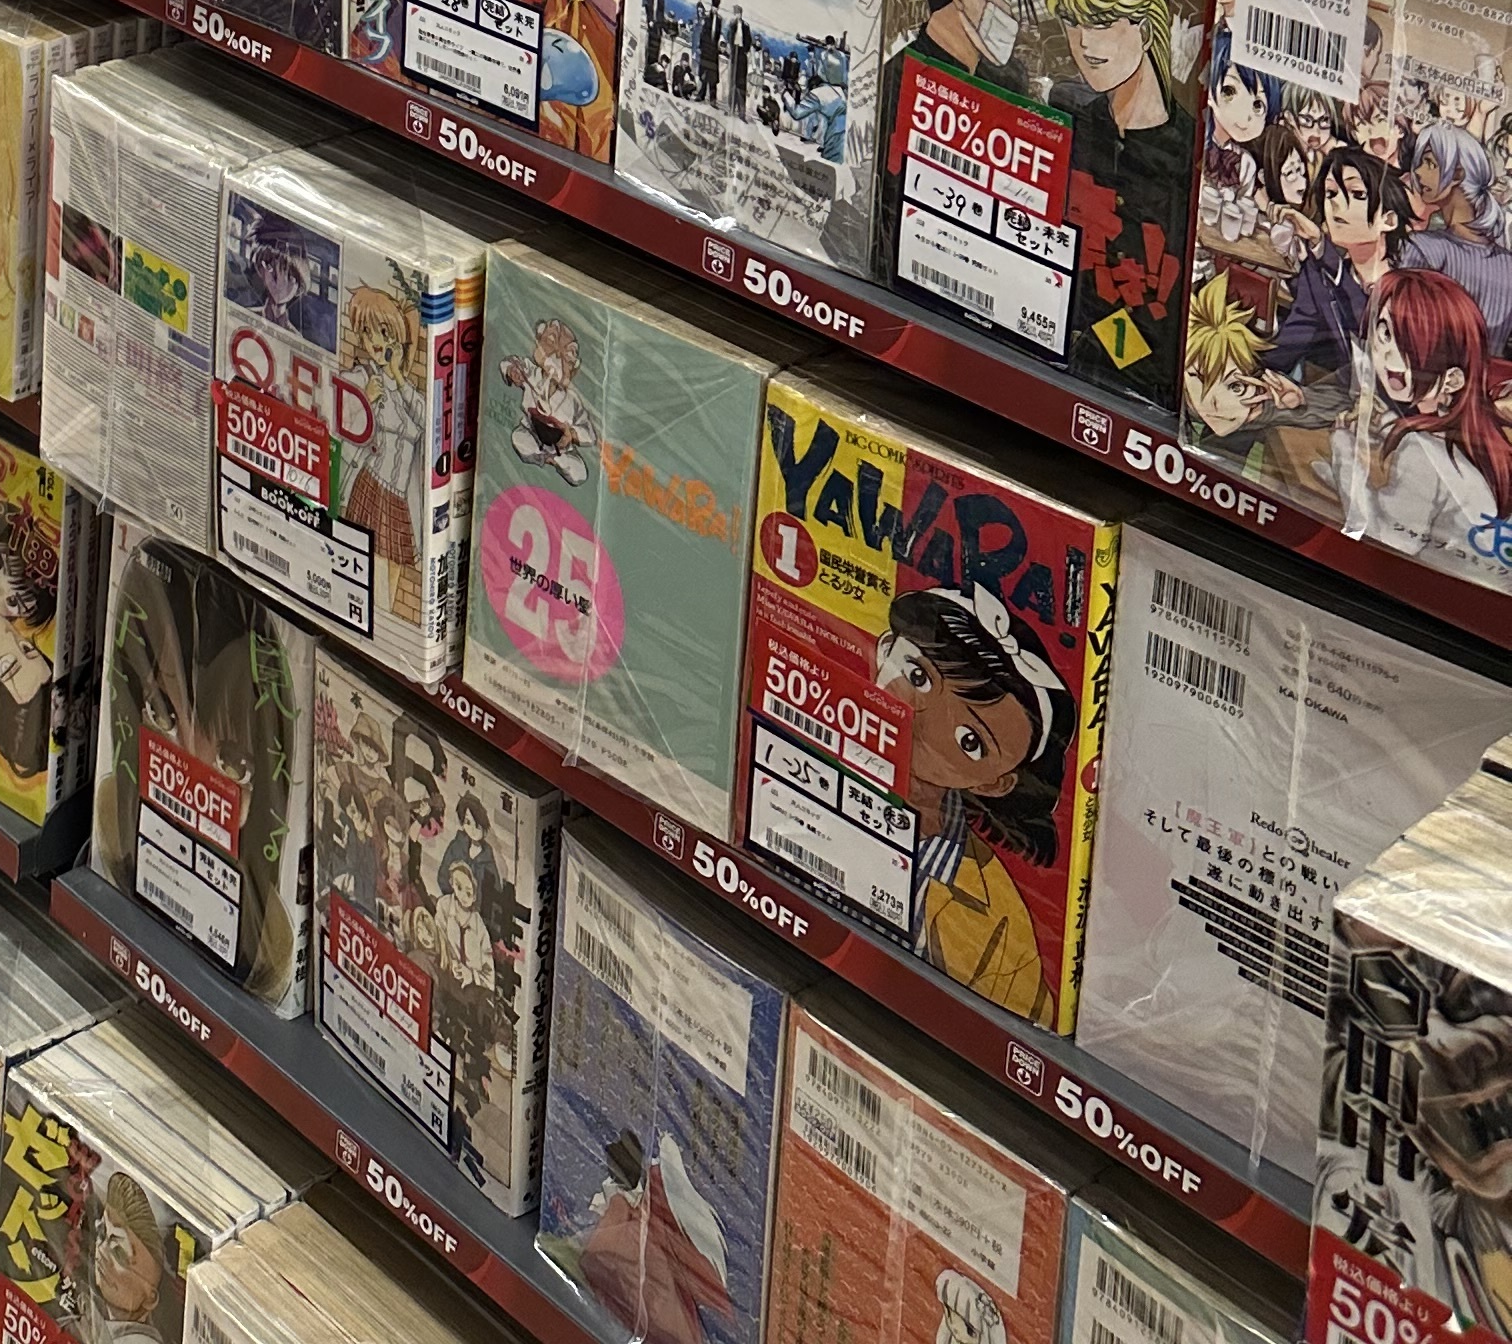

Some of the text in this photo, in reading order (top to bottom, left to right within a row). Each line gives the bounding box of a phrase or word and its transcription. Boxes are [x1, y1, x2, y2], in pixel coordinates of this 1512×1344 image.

[192, 8, 272, 64] 50%OFF
[1245, 42, 1344, 86] 1929979004804
[438, 117, 537, 188] 50%OFF
[911, 92, 1055, 184] 50%OFF
[743, 262, 867, 339] 50%OFF
[226, 406, 322, 471] 50%OFF
[1122, 426, 1278, 529] 50%OFF
[766, 402, 1087, 650] YAWARA!
[508, 555, 591, 617] 世界の厚い壁
[818, 571, 867, 604] とる少女
[1150, 604, 1251, 658] 9784041115756
[765, 659, 899, 754] 50%OFF
[1144, 666, 1245, 721] 1920979006409
[148, 758, 233, 826] 50%OFF
[691, 841, 809, 939] 50%OFF
[1309, 840, 1351, 870] healer
[1206, 863, 1324, 931] 遂に動き出す
[135, 961, 212, 1043] 50%OFF
[338, 927, 424, 1012] 50%OFF
[1055, 1075, 1202, 1196] 50%OFF
[366, 1160, 459, 1254] 50%OFF
